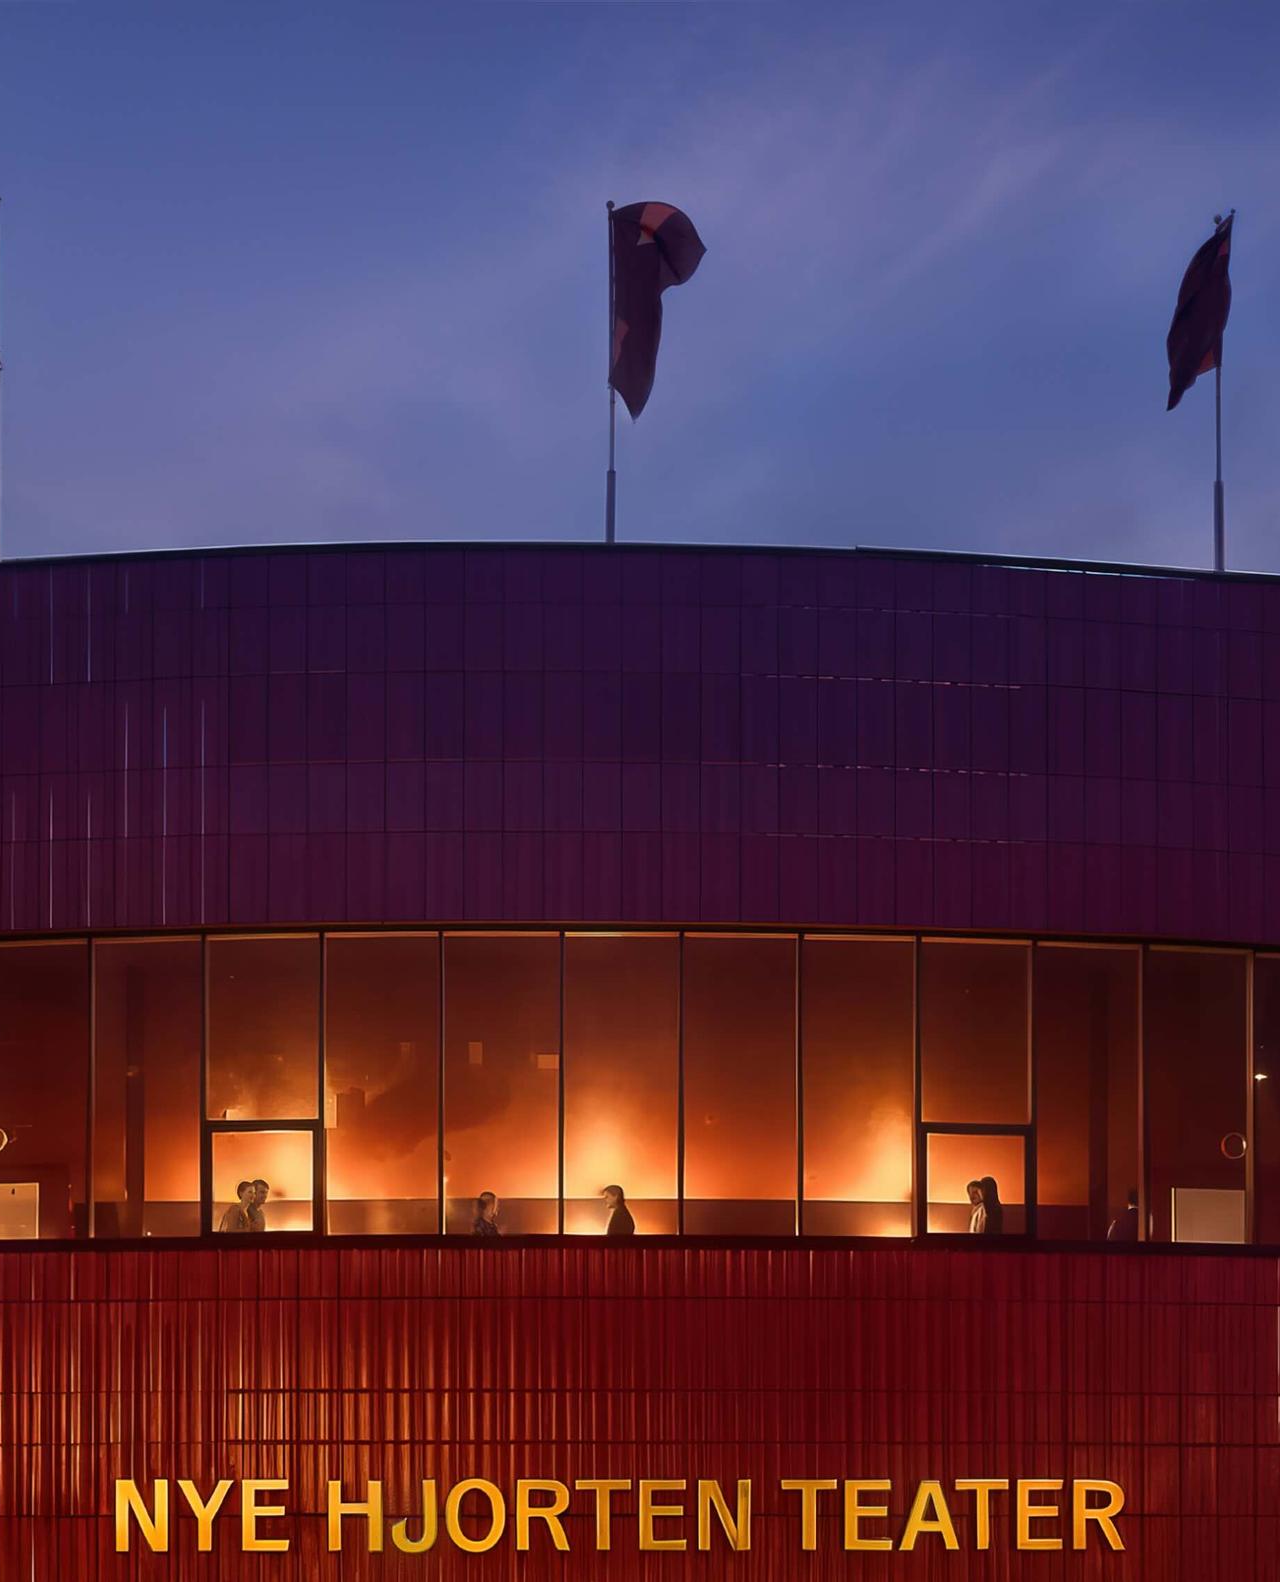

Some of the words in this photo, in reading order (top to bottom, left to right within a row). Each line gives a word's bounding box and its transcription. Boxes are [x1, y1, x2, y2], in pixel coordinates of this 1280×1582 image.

[115, 1478, 290, 1553] NYE
[327, 1478, 752, 1554] HJORTEN
[780, 1478, 1126, 1552] TEATER
